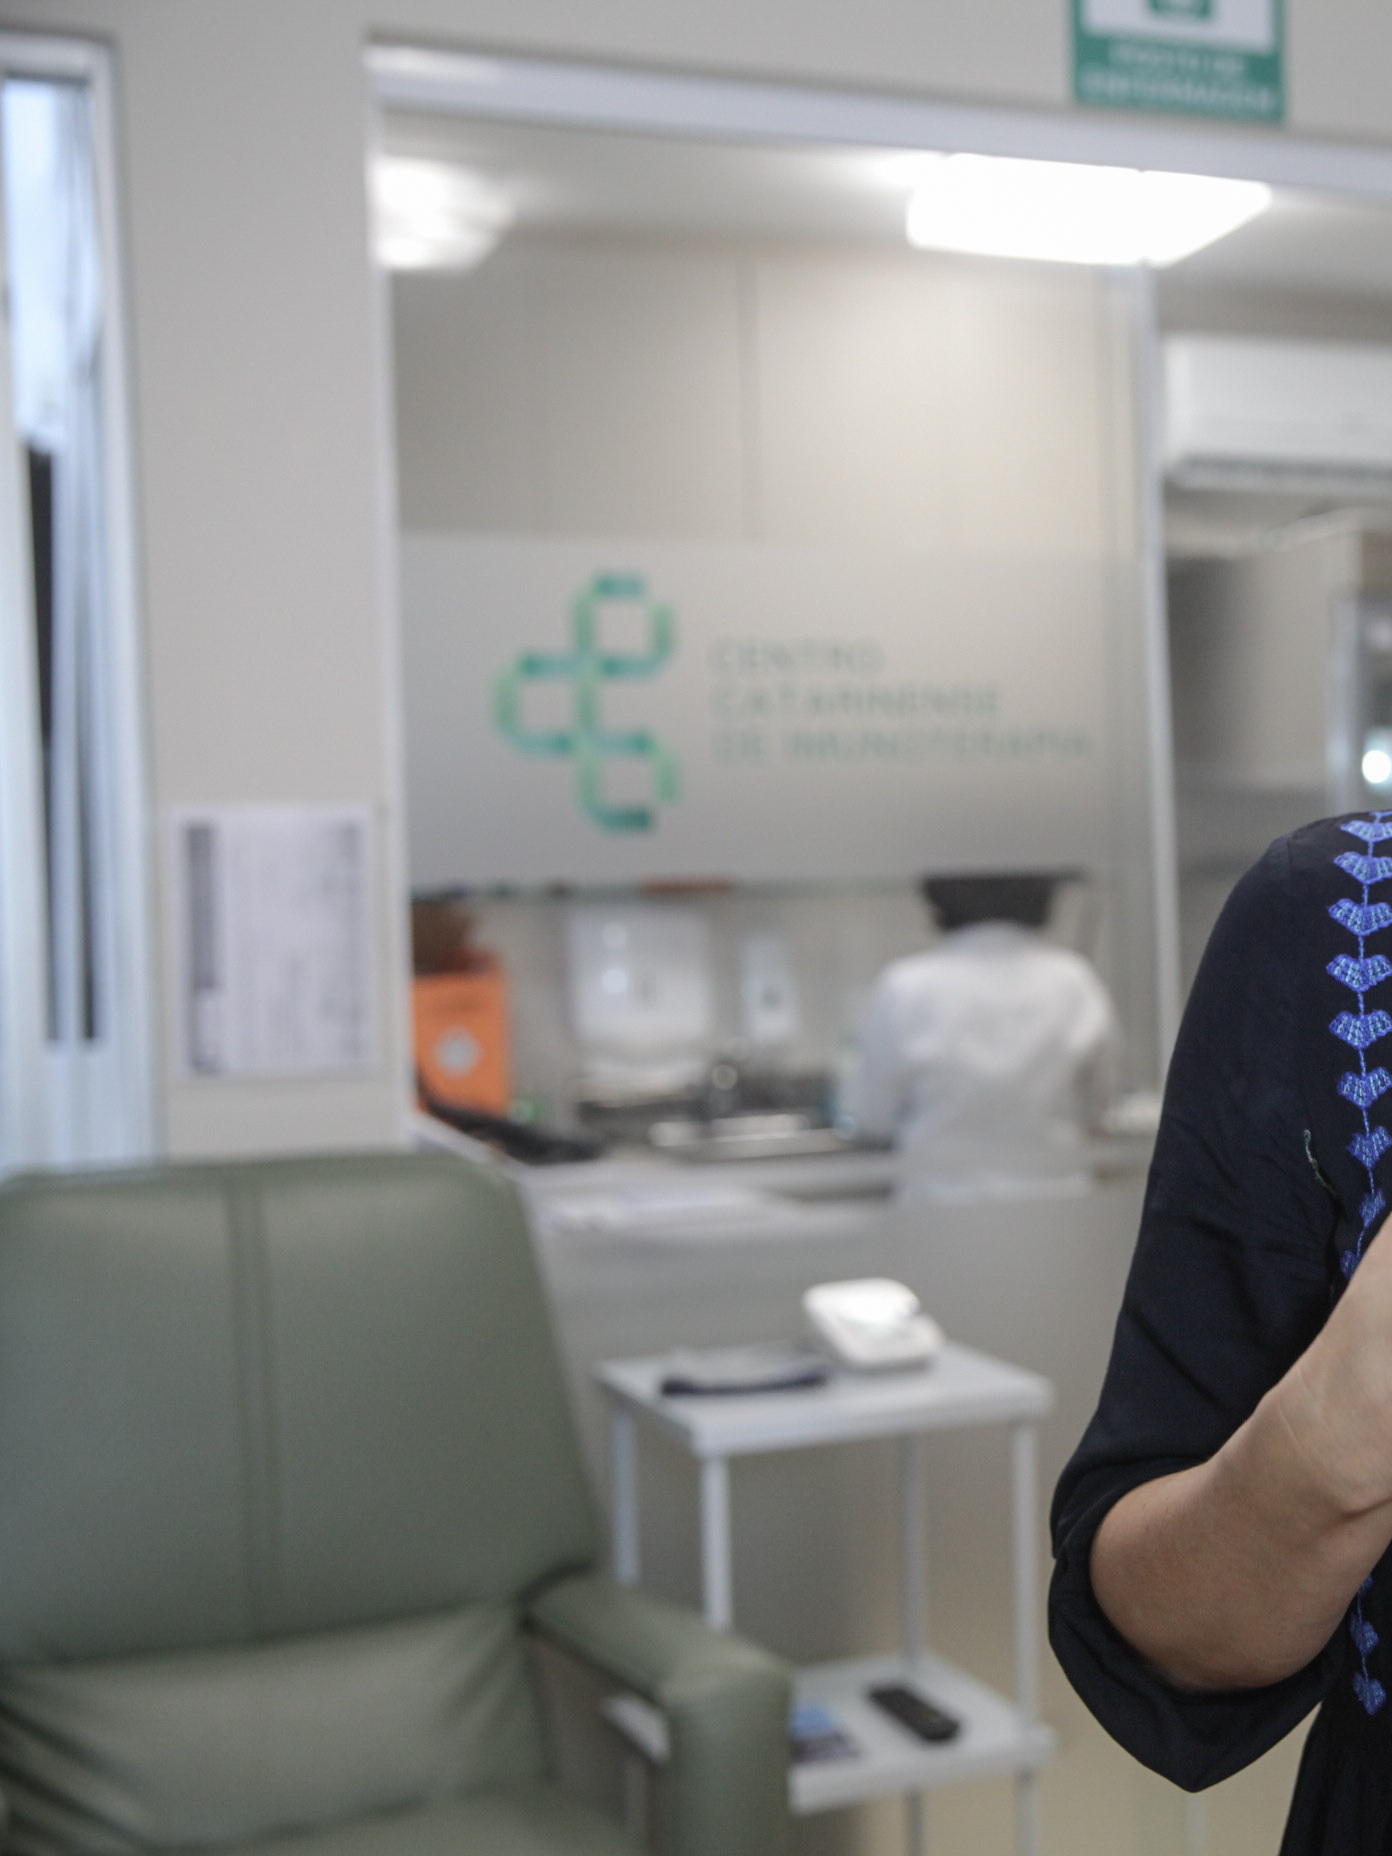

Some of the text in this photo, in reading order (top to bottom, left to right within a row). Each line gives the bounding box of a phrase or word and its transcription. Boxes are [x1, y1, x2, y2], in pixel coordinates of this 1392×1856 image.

[1083, 67, 1276, 114] ENFERMAGEM
[709, 638, 884, 678] CENTRO
[710, 683, 1005, 720] CATARINENSE
[713, 725, 1094, 764] DE IMUNOTERAPIA
